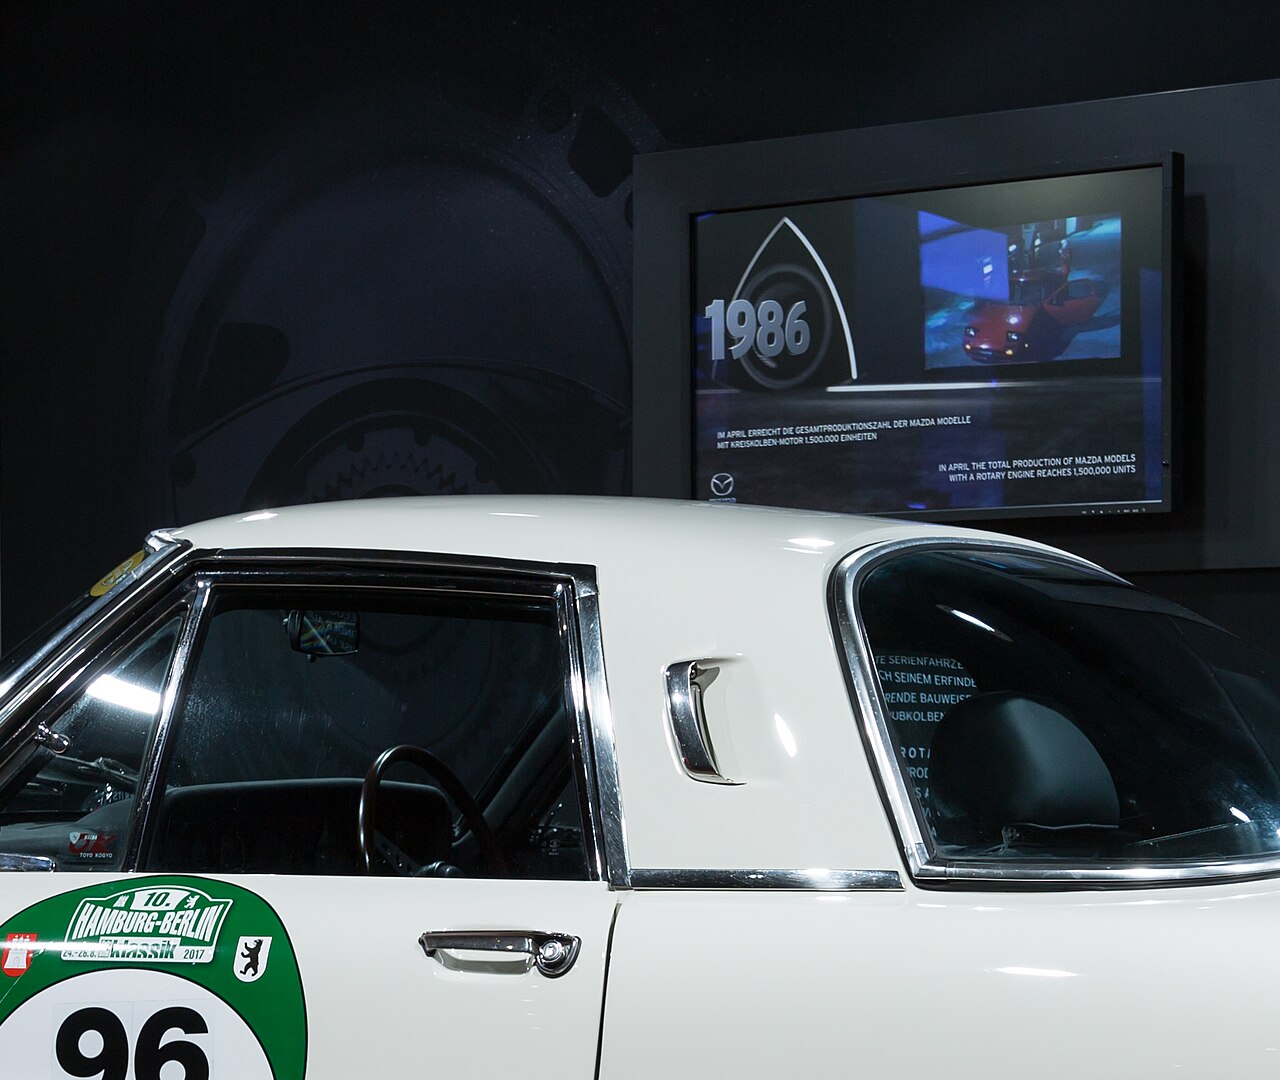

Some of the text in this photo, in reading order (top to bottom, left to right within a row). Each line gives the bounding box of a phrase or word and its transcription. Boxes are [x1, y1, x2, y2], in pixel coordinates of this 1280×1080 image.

[704, 299, 811, 361] 1986
[726, 430, 748, 439] APRIL
[748, 427, 782, 438] ERREICHT
[782, 426, 795, 436] DIE
[893, 419, 909, 429] DER
[909, 418, 936, 427] MAZDA
[936, 415, 972, 426] MODELLE
[938, 464, 947, 472] IN
[948, 462, 971, 472] APRIL
[971, 461, 987, 470] THE
[987, 460, 1012, 470] TOTAL
[1062, 456, 1074, 466] OF
[1074, 455, 1103, 465] MAZDA
[1104, 453, 1136, 464] MODELS
[948, 473, 968, 482] WITH
[976, 471, 1006, 481] ROTARY
[1007, 469, 1036, 480] ENGINE
[1036, 467, 1073, 478] REACHES
[1112, 464, 1136, 474] UNITS
[894, 671, 932, 685] SEINEM
[143, 891, 171, 907] 10.
[71, 902, 225, 942] HAMBURG-BERLIN
[183, 949, 206, 960] 2017
